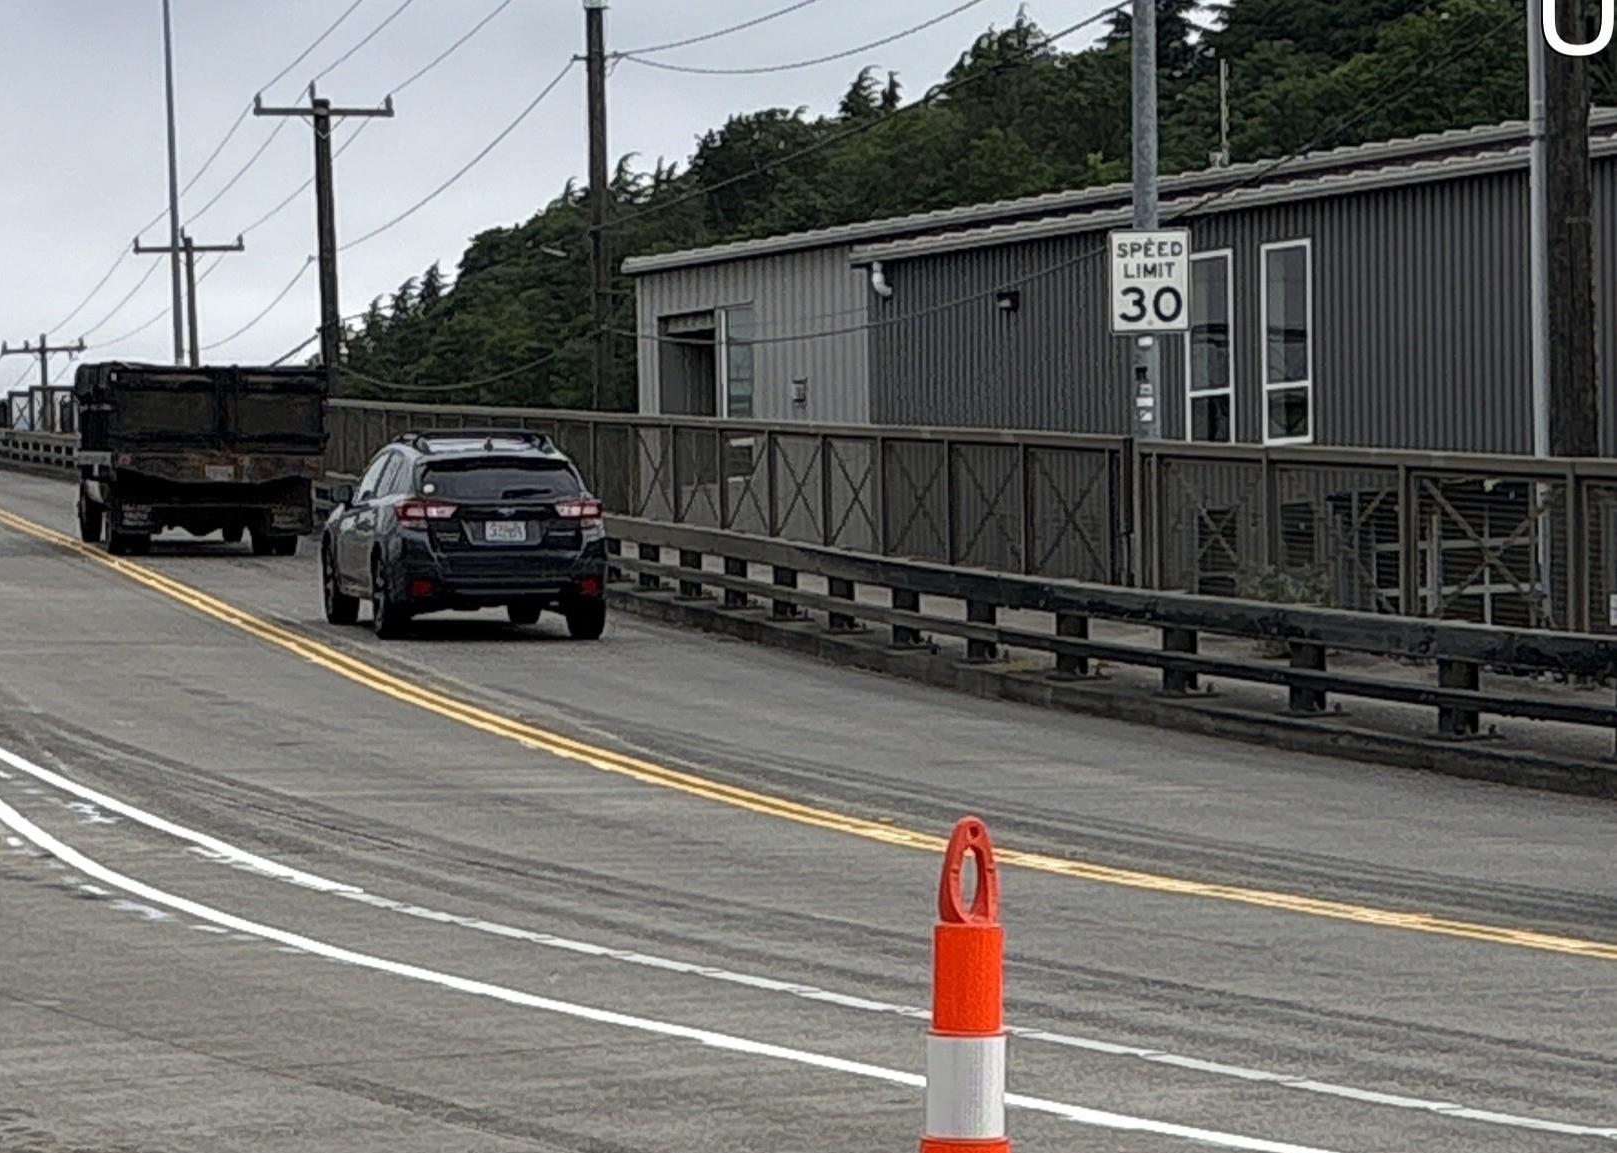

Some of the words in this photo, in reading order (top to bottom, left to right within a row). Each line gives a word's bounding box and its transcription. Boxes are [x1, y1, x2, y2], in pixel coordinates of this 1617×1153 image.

[1116, 241, 1183, 259] SPEED
[1123, 262, 1176, 279] LIMIT
[1119, 286, 1183, 323] 30
